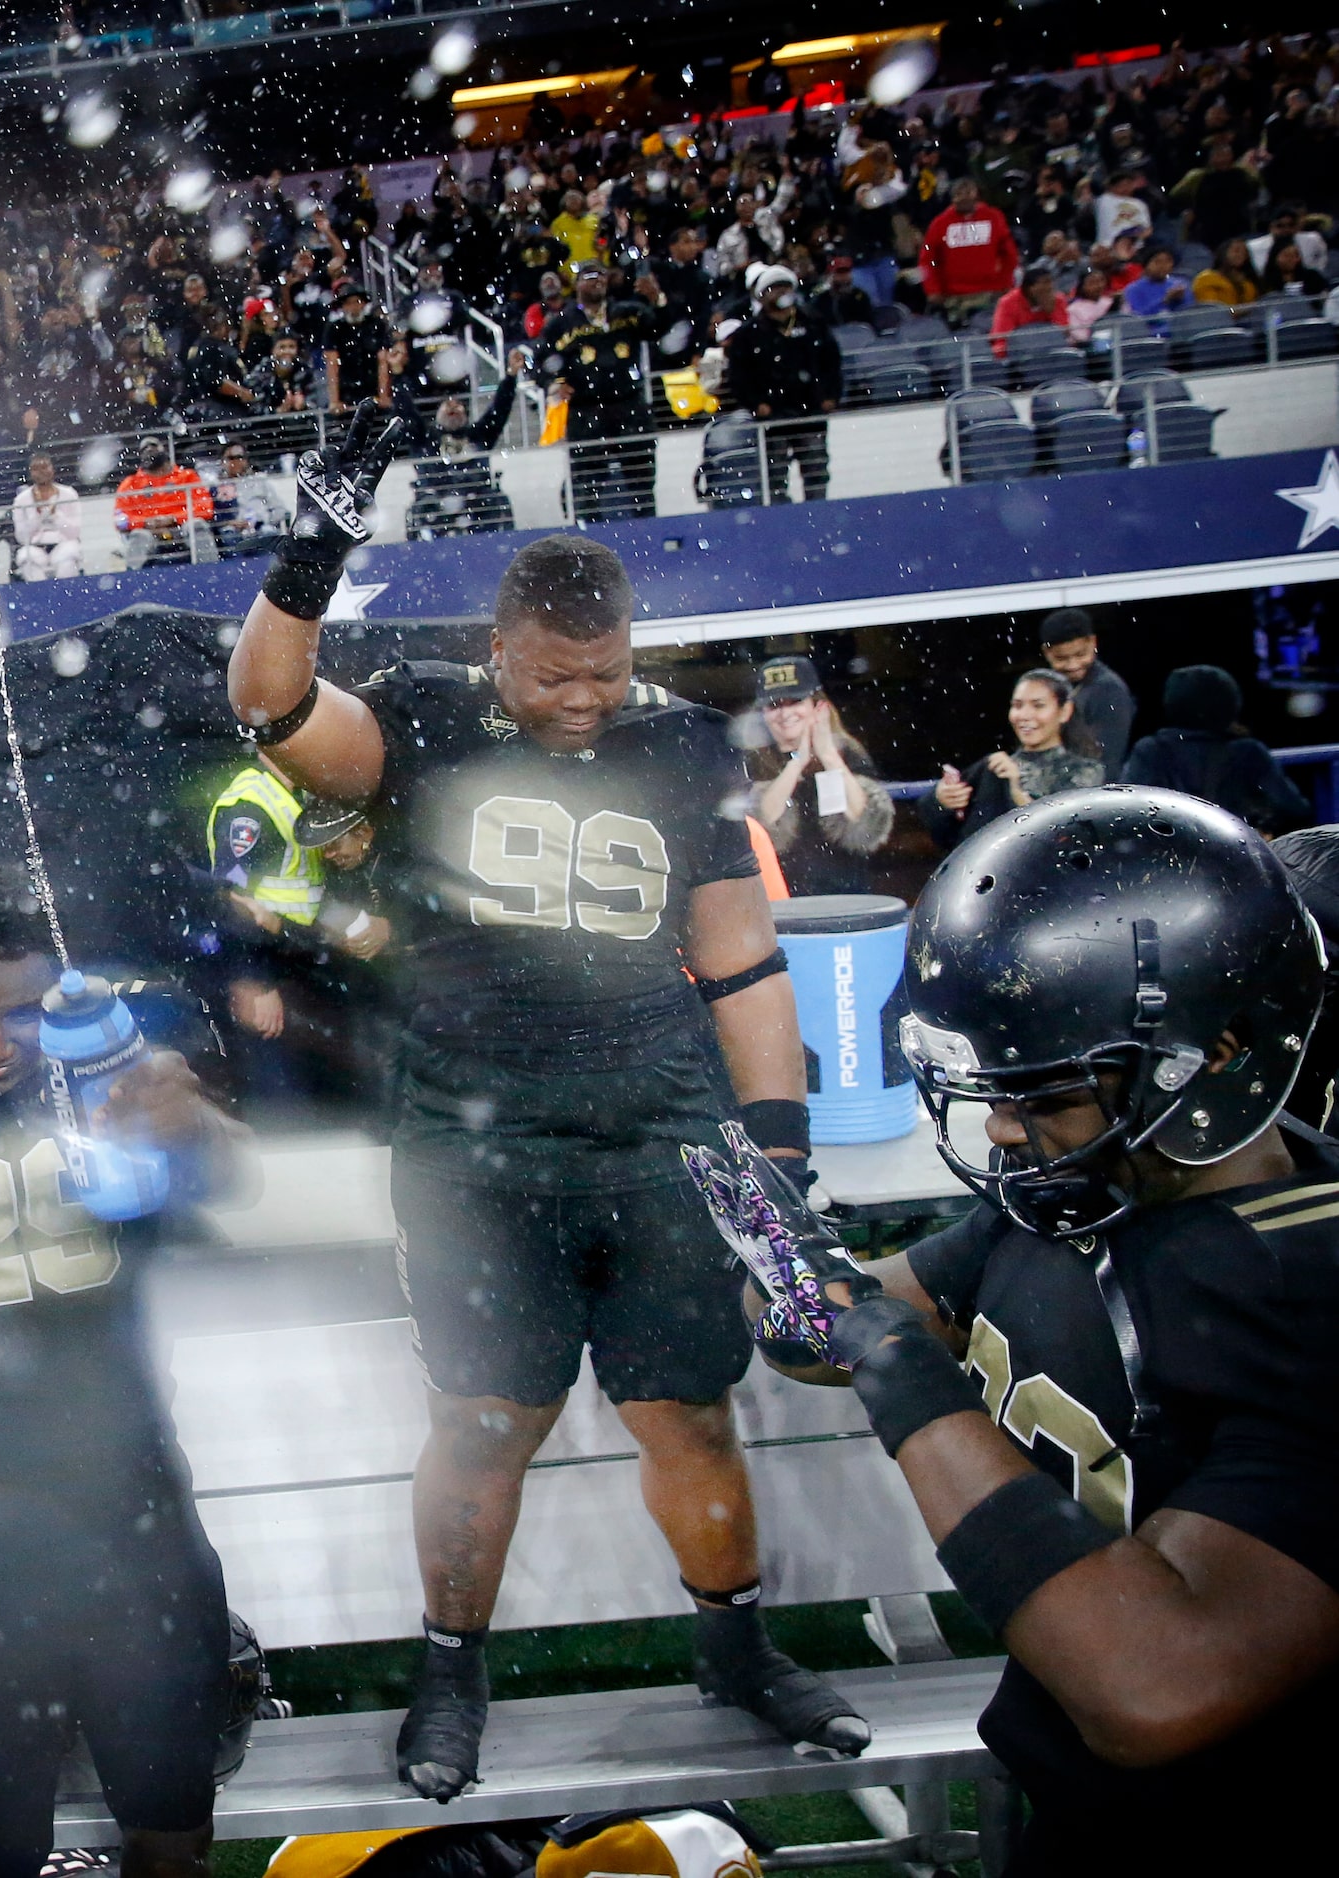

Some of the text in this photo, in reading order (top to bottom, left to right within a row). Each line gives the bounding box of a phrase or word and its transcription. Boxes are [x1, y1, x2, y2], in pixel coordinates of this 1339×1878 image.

[469, 795, 670, 941] 99
[833, 943, 859, 1088] POWERADE
[47, 1056, 90, 1189] POWERADE
